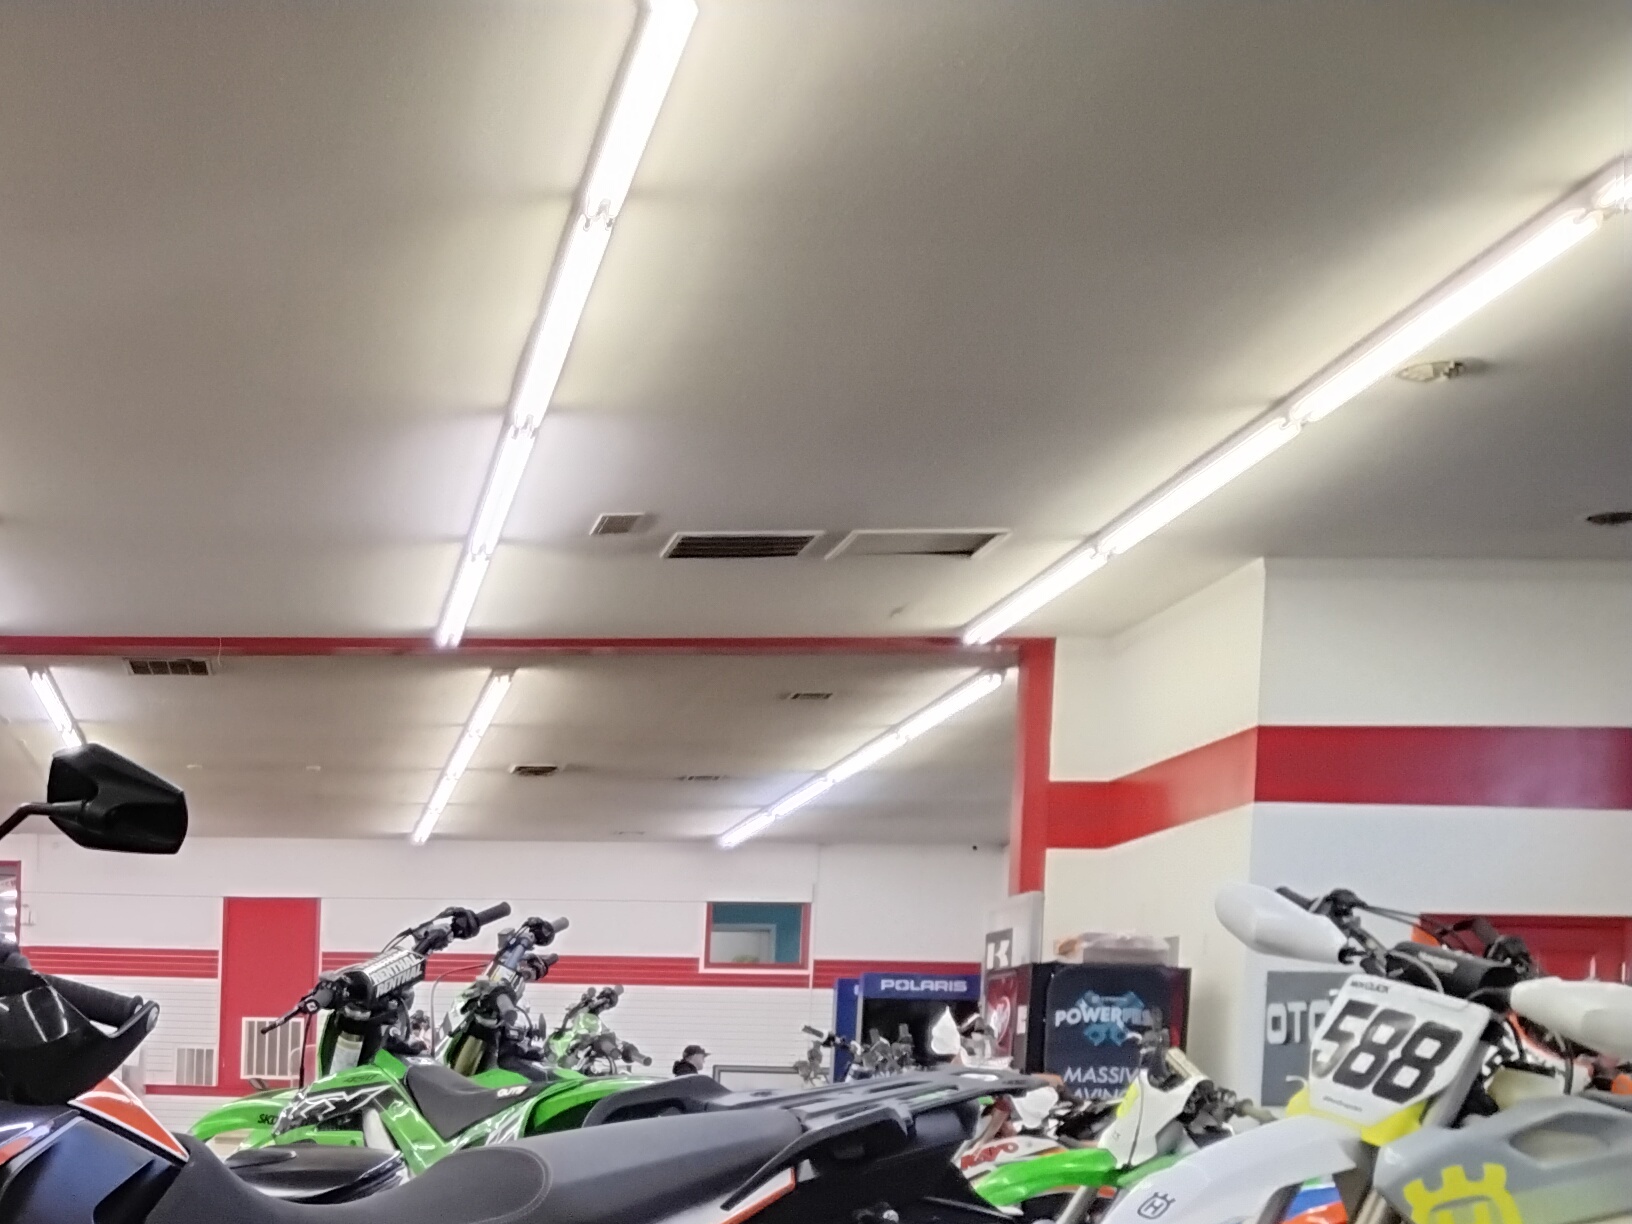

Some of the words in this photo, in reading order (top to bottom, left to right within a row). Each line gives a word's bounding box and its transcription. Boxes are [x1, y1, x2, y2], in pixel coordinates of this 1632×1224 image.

[880, 979, 968, 992] POLARIS
[1055, 999, 1152, 1030] POWERFES
[1312, 999, 1462, 1105] 588
[1064, 1067, 1139, 1083] MASSIV
